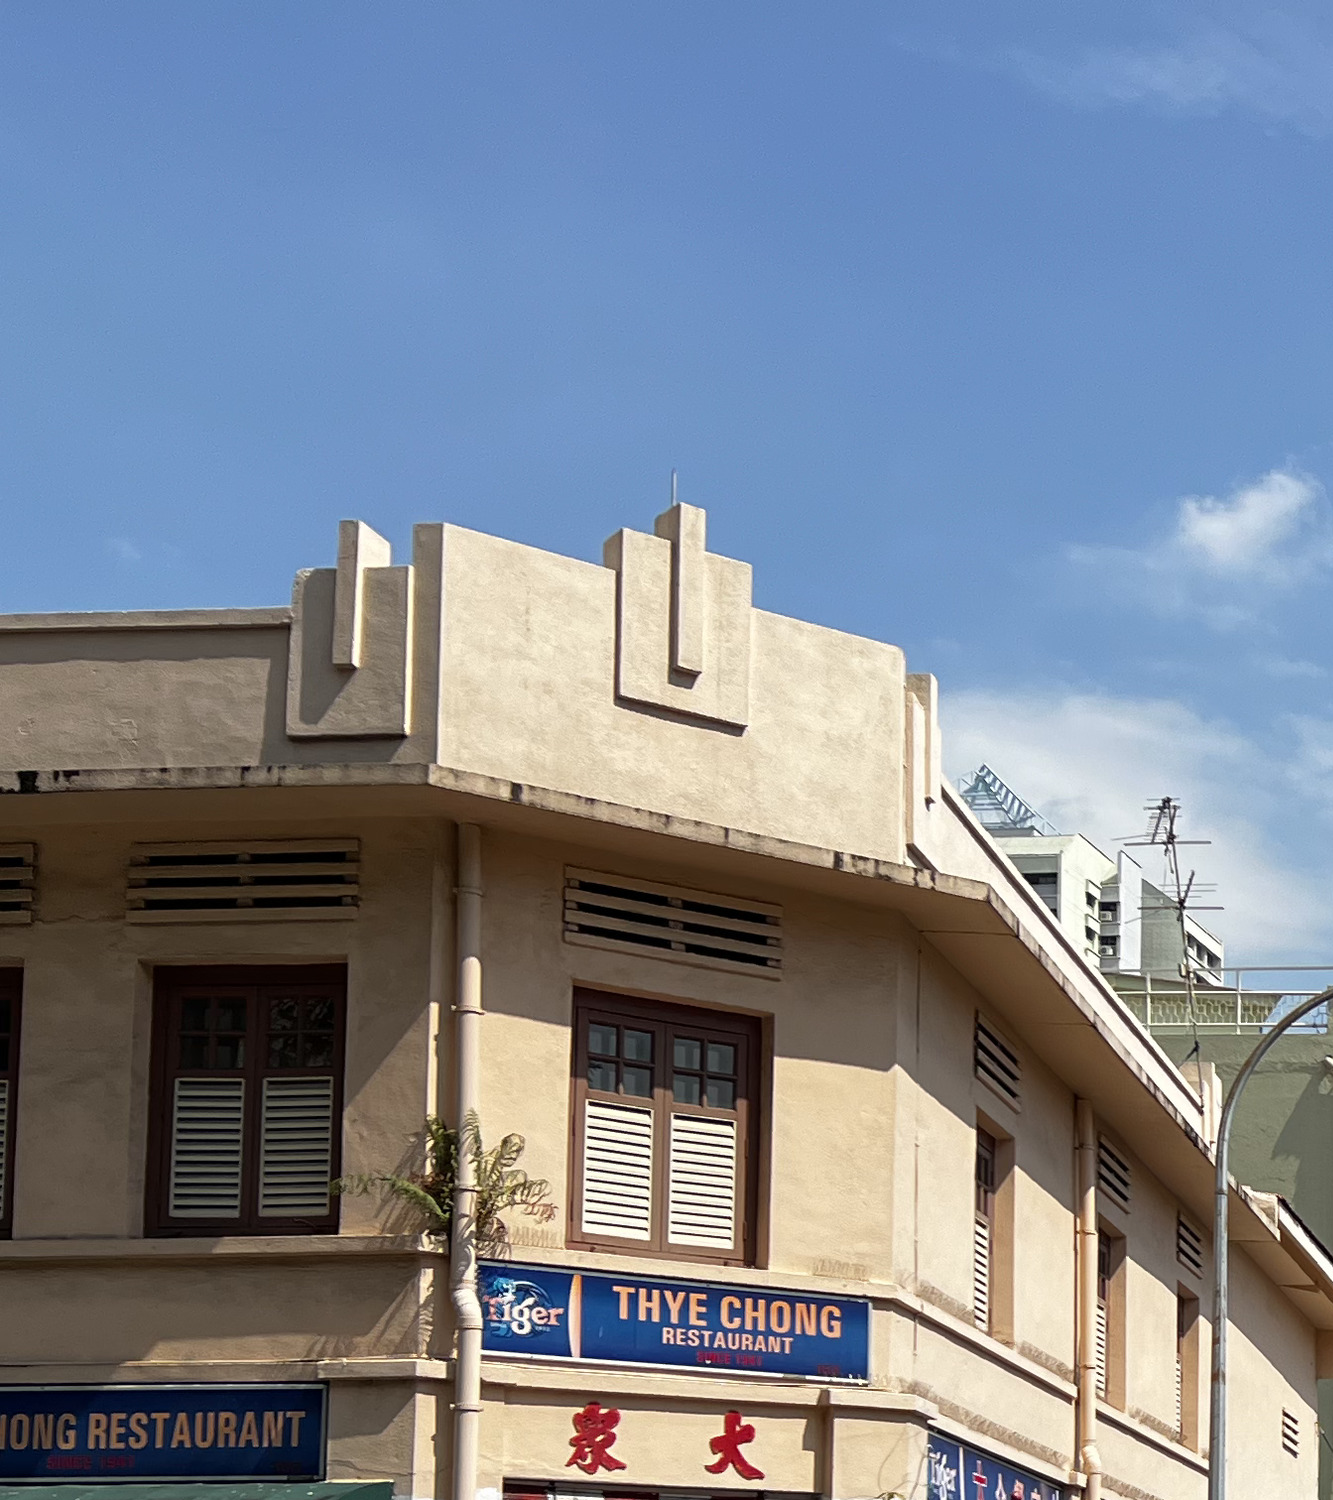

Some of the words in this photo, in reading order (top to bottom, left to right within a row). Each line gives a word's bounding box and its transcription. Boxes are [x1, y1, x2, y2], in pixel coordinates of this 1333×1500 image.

[483, 1294, 564, 1335] Tiger
[612, 1285, 708, 1326] THYE
[720, 1296, 843, 1339] CHONG
[661, 1326, 795, 1355] RESTAURANT
[87, 1411, 306, 1450] RESTAURANT
